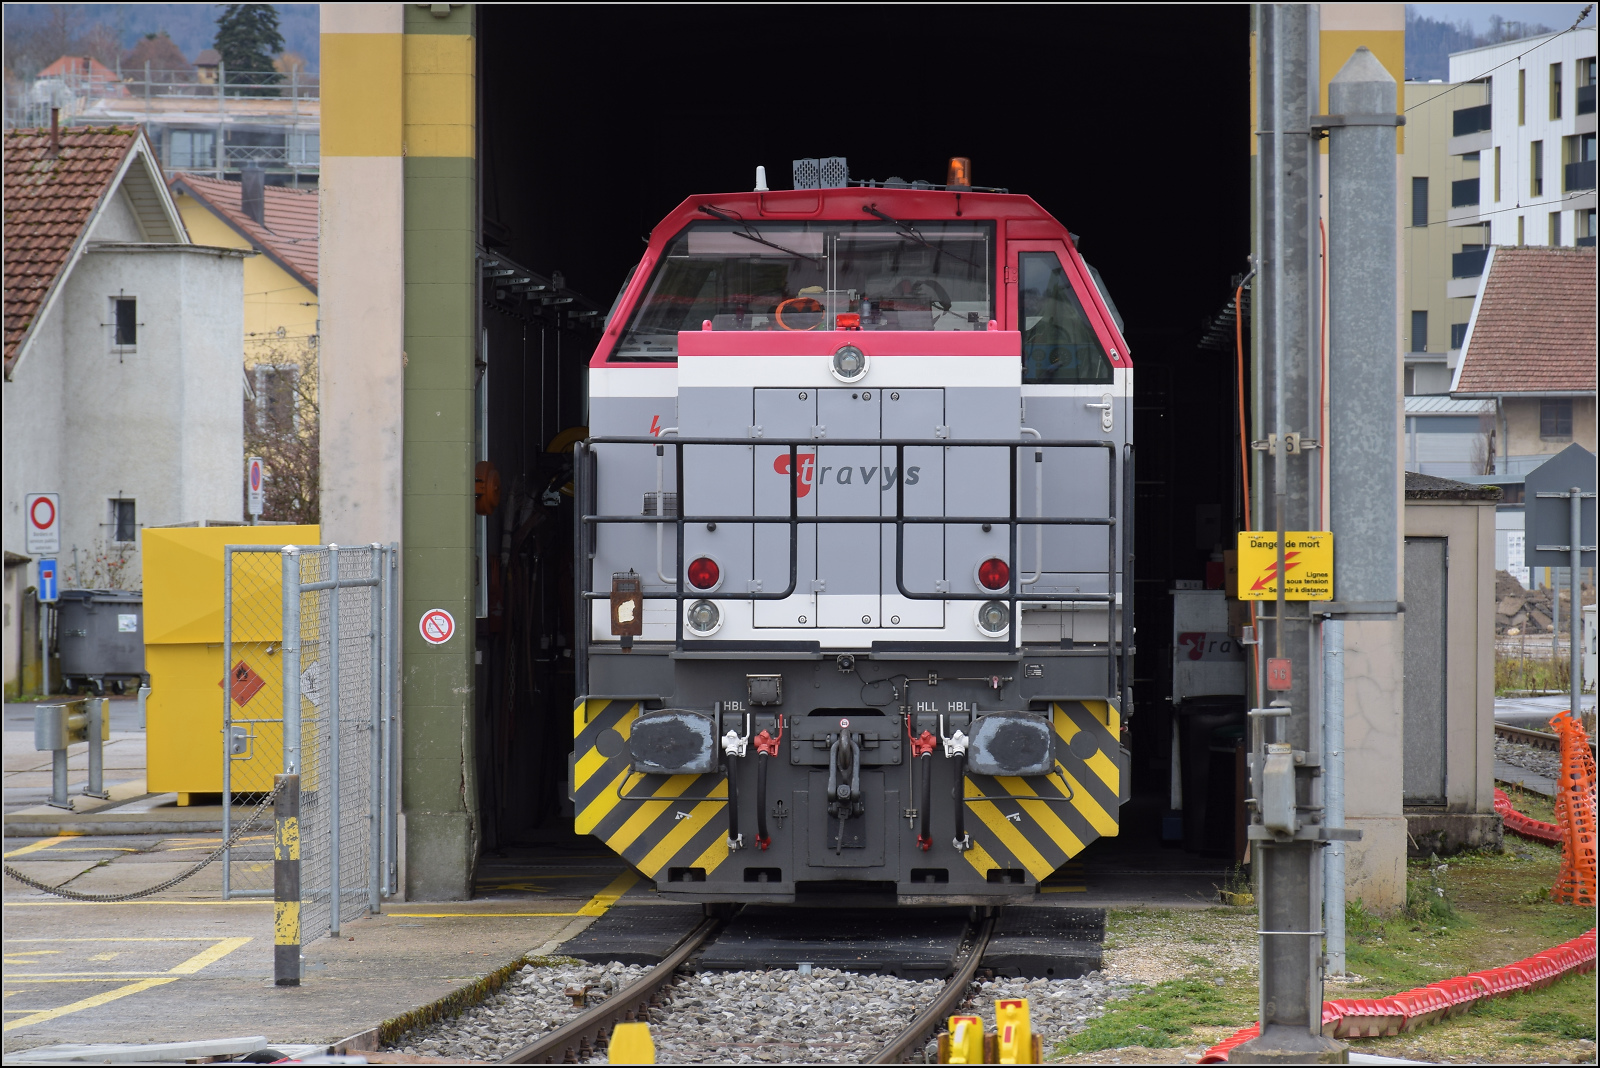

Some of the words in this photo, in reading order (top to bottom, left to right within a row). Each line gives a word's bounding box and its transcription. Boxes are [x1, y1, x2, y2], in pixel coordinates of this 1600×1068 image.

[801, 457, 921, 491] travys
[1250, 540, 1279, 549] Dange
[1285, 540, 1296, 548] de
[1299, 540, 1320, 548] mort
[1306, 571, 1329, 579] Lignes
[1273, 669, 1286, 680] 16
[723, 701, 746, 711] HBL
[917, 701, 939, 712] HLL
[948, 701, 970, 712] HBL
